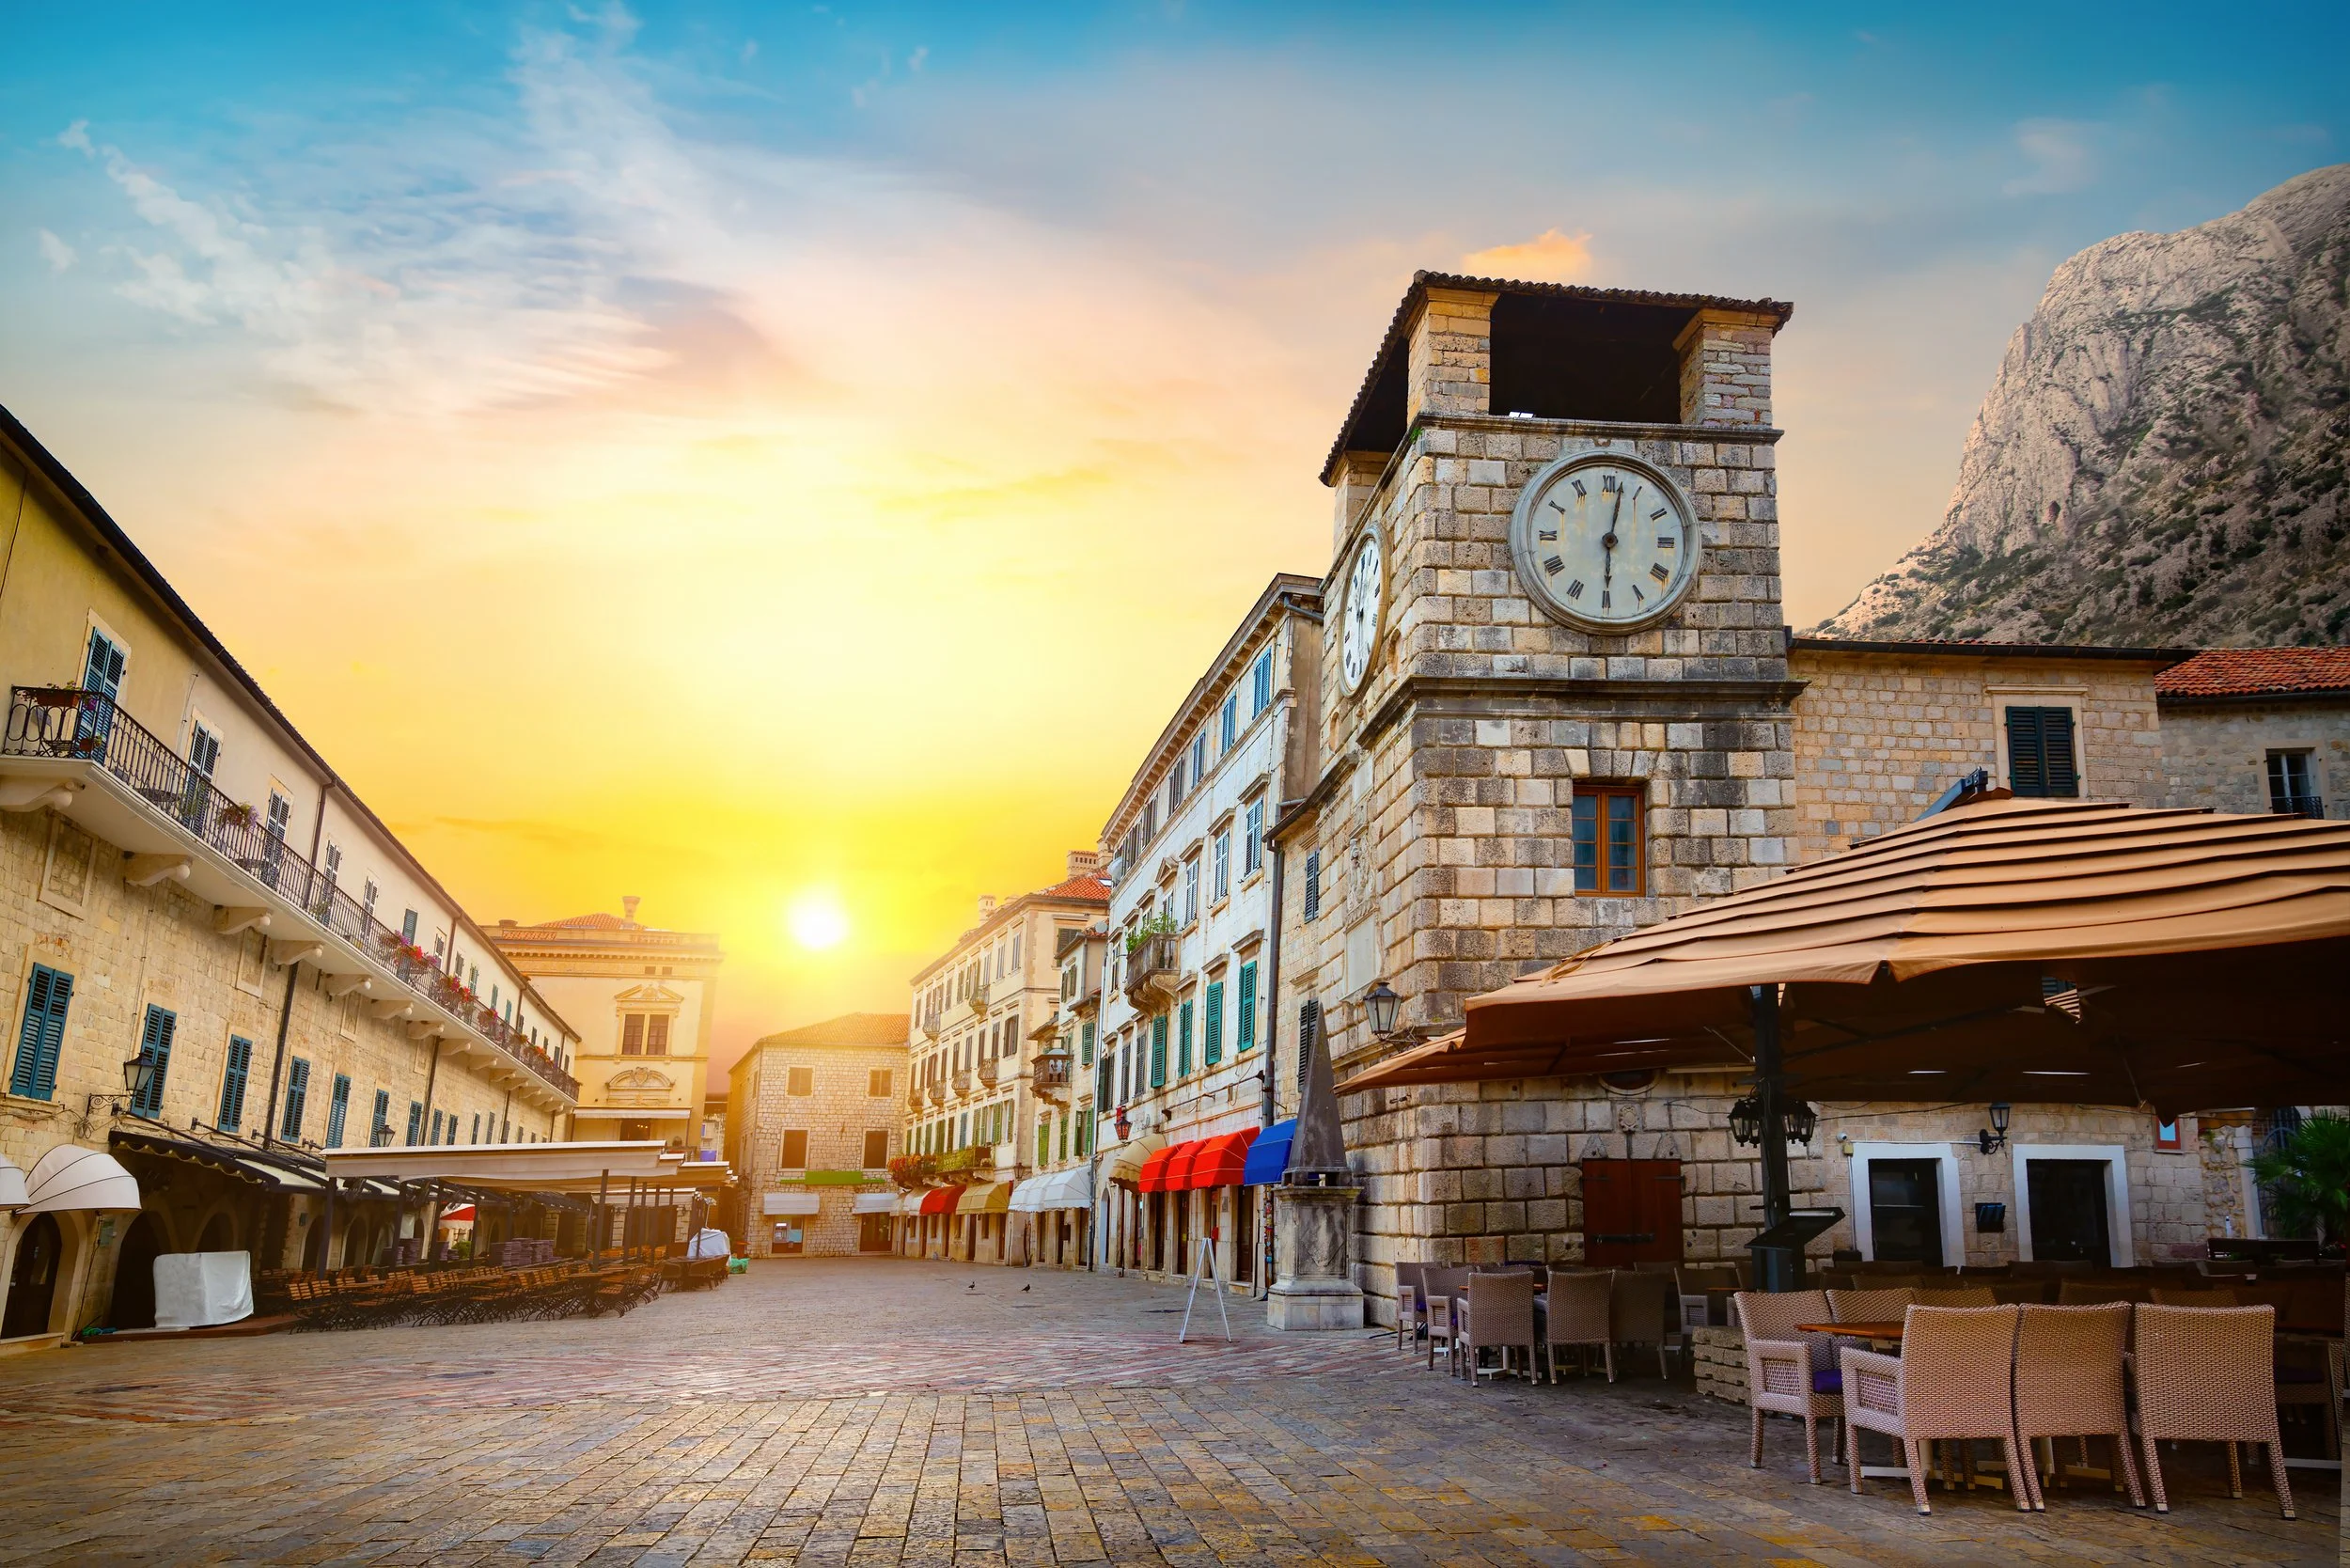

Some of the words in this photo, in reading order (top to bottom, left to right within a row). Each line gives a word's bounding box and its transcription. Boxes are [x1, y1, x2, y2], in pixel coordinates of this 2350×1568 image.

[1572, 479, 1587, 497] XI
[1603, 475, 1615, 493] XII
[1633, 486, 1642, 500] I
[1548, 500, 1565, 514] X
[1650, 508, 1667, 521] II
[1539, 530, 1557, 541] IX
[1657, 537, 1674, 548] III
[1543, 555, 1565, 576] VIII
[1567, 579, 1584, 600] VII
[1632, 584, 1644, 600] V
[1602, 590, 1611, 608] VI
